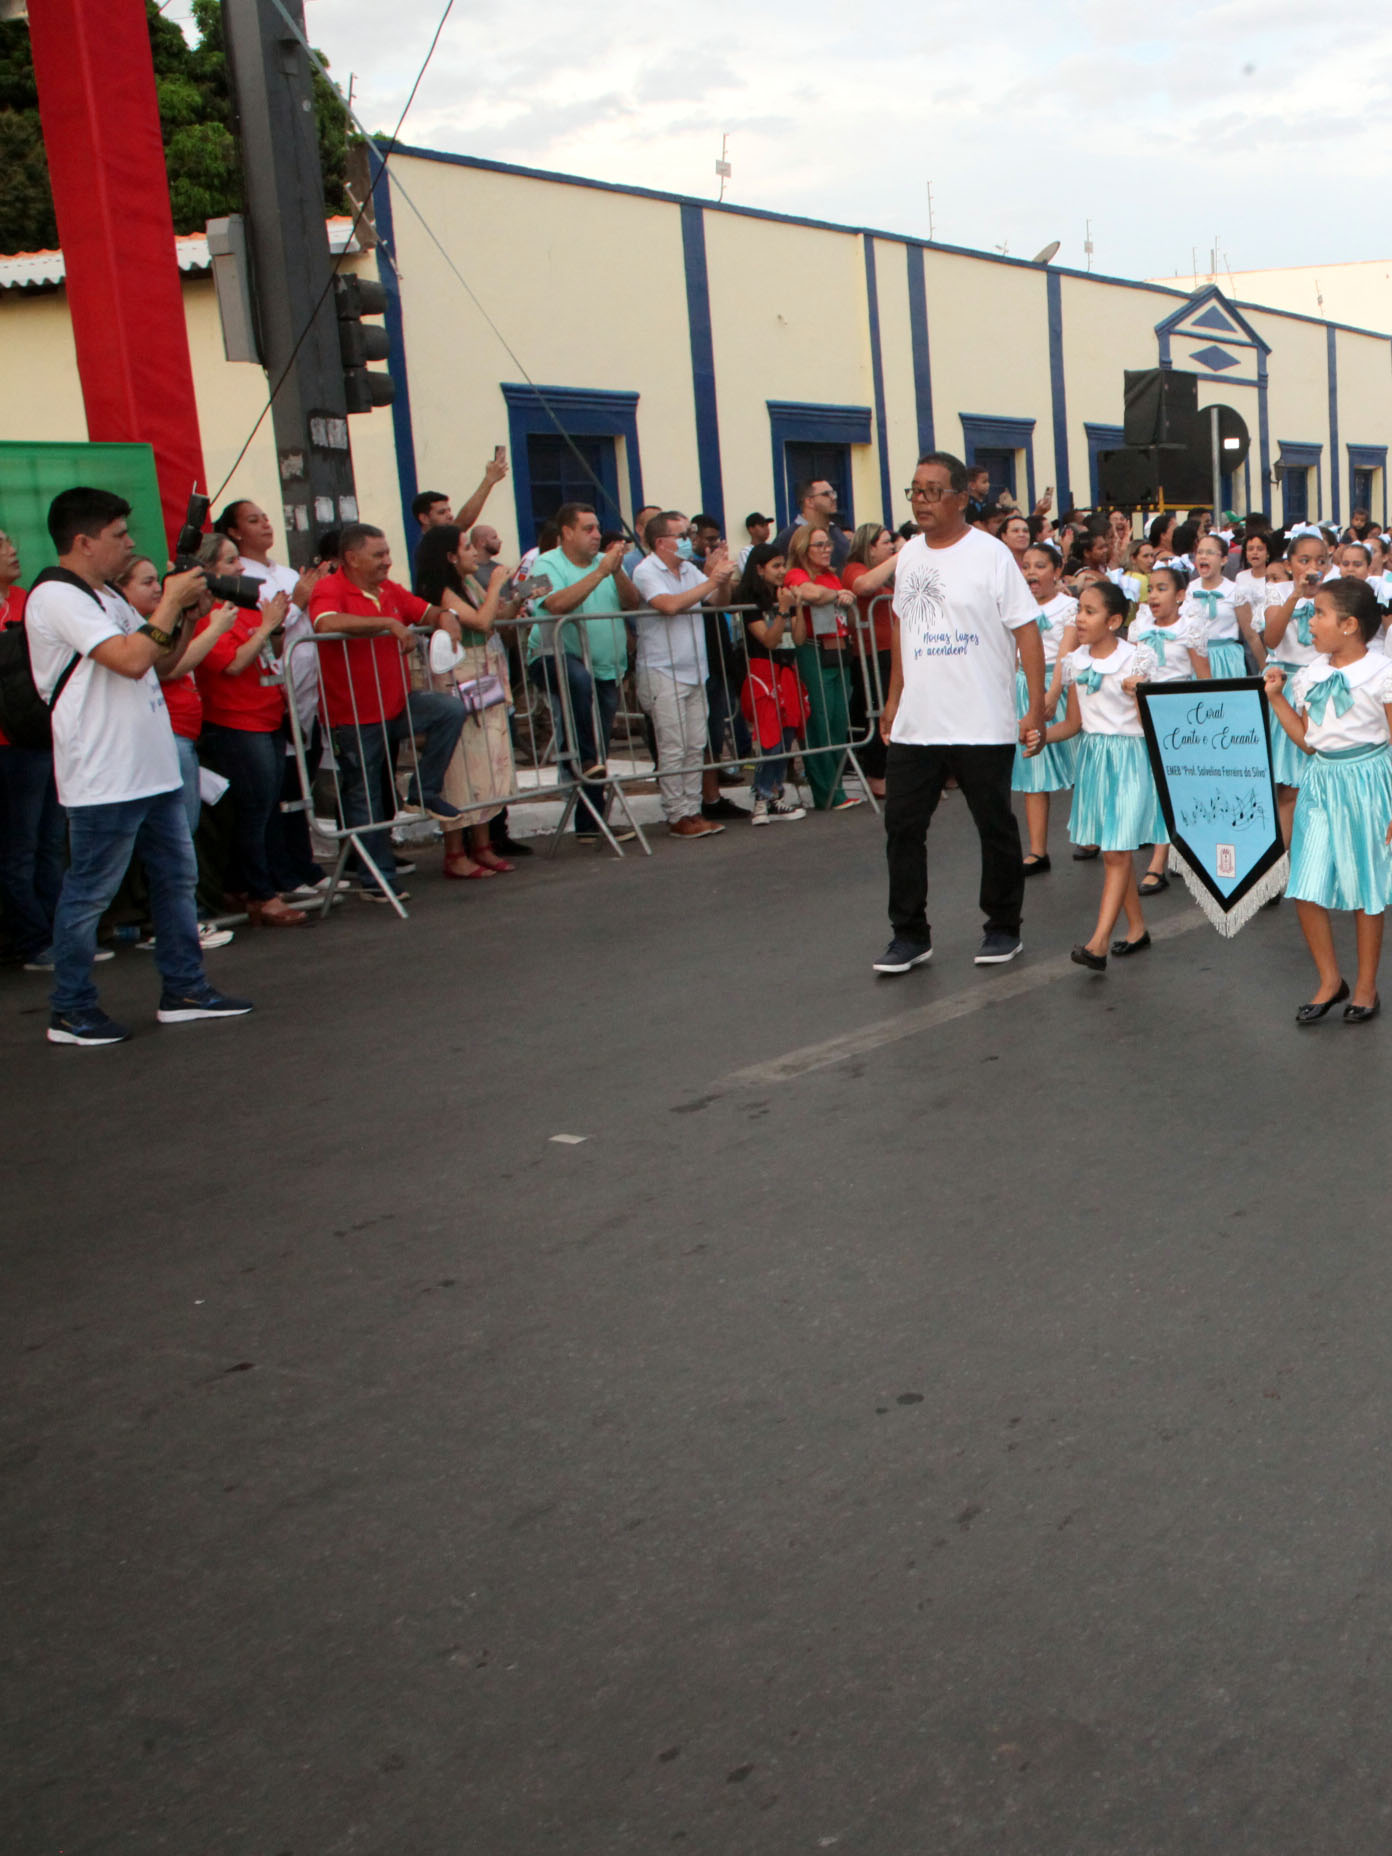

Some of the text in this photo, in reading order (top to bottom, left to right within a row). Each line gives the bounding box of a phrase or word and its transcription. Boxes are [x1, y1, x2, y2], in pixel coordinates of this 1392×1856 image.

[1187, 701, 1224, 725] Coral
[1163, 727, 1201, 750] Canto
[1212, 726, 1260, 750] Encanto
[1222, 766, 1243, 777] Ferreira
[1244, 766, 1251, 777] da
